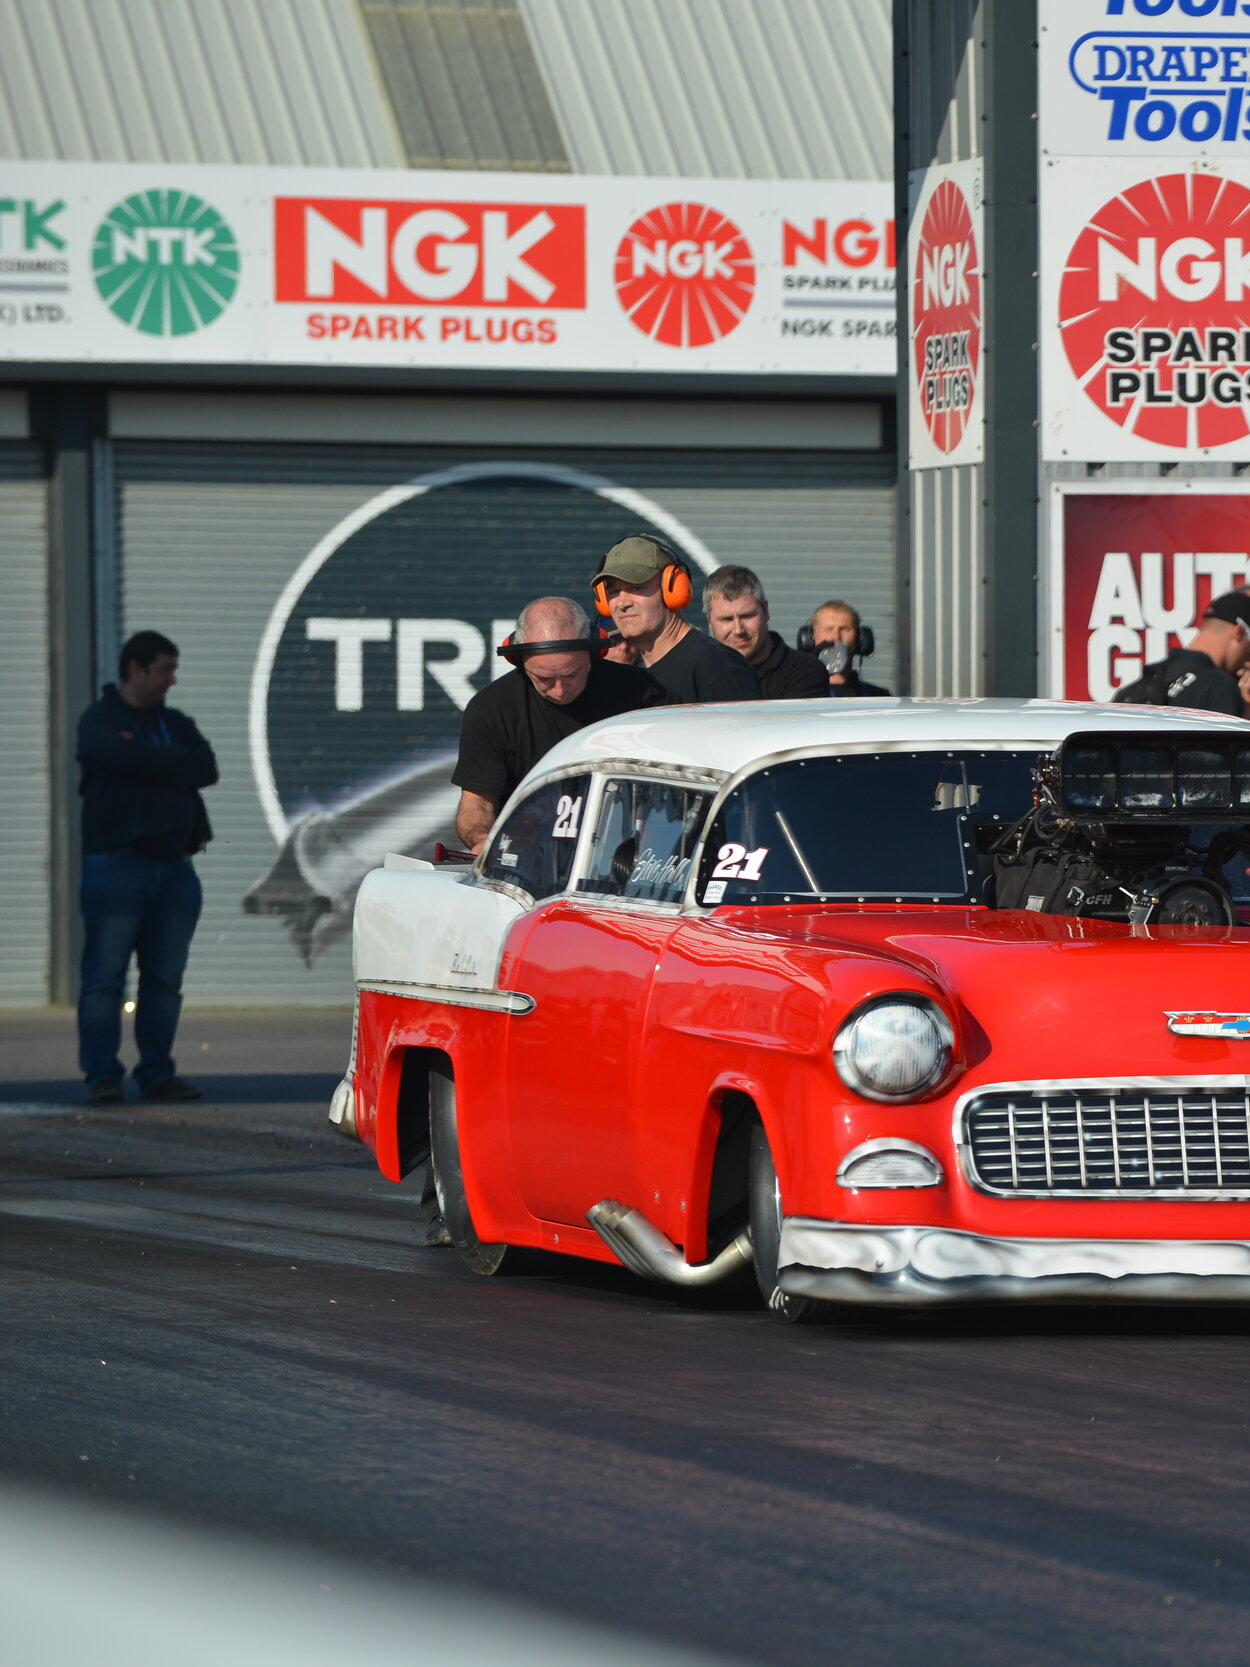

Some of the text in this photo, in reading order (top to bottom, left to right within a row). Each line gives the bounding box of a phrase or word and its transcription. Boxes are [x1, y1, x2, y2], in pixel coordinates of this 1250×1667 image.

[111, 227, 218, 266] NTK
[305, 205, 557, 304] NGK
[632, 239, 735, 280] NGK
[783, 276, 853, 290] SPARK
[922, 240, 971, 311] NGK
[306, 313, 558, 344] SPARK PLUGS
[782, 319, 833, 338] NGK
[925, 330, 970, 374] SPARK
[925, 370, 970, 413] PLUGS
[552, 794, 583, 838] 21
[711, 842, 770, 881] 21
